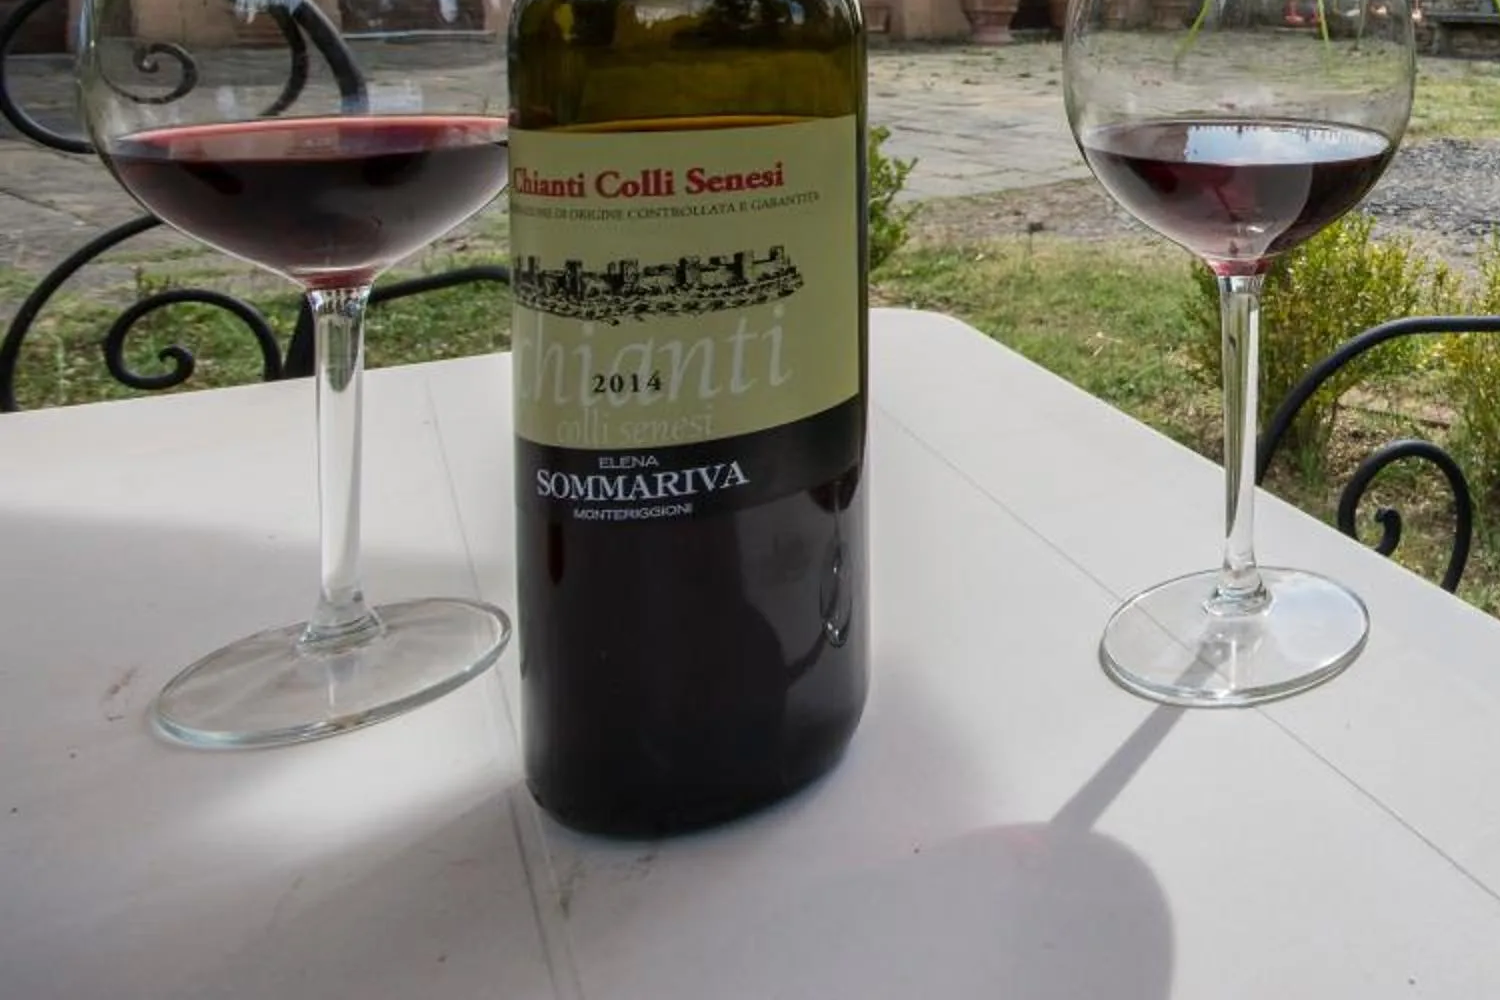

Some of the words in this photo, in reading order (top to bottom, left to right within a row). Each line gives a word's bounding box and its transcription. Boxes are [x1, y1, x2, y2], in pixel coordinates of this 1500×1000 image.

[513, 167, 585, 198] Chianti
[595, 168, 675, 198] Colli
[685, 161, 785, 195] Senesi
[627, 204, 735, 219] CONTROLLATA
[738, 203, 748, 213] E
[592, 370, 662, 394] 2014
[557, 406, 608, 444] colli
[620, 402, 714, 443] senesi
[598, 455, 660, 469] ELENA
[536, 460, 751, 502] SOMMARIVA
[573, 503, 694, 522] MONTERIGGIONI
